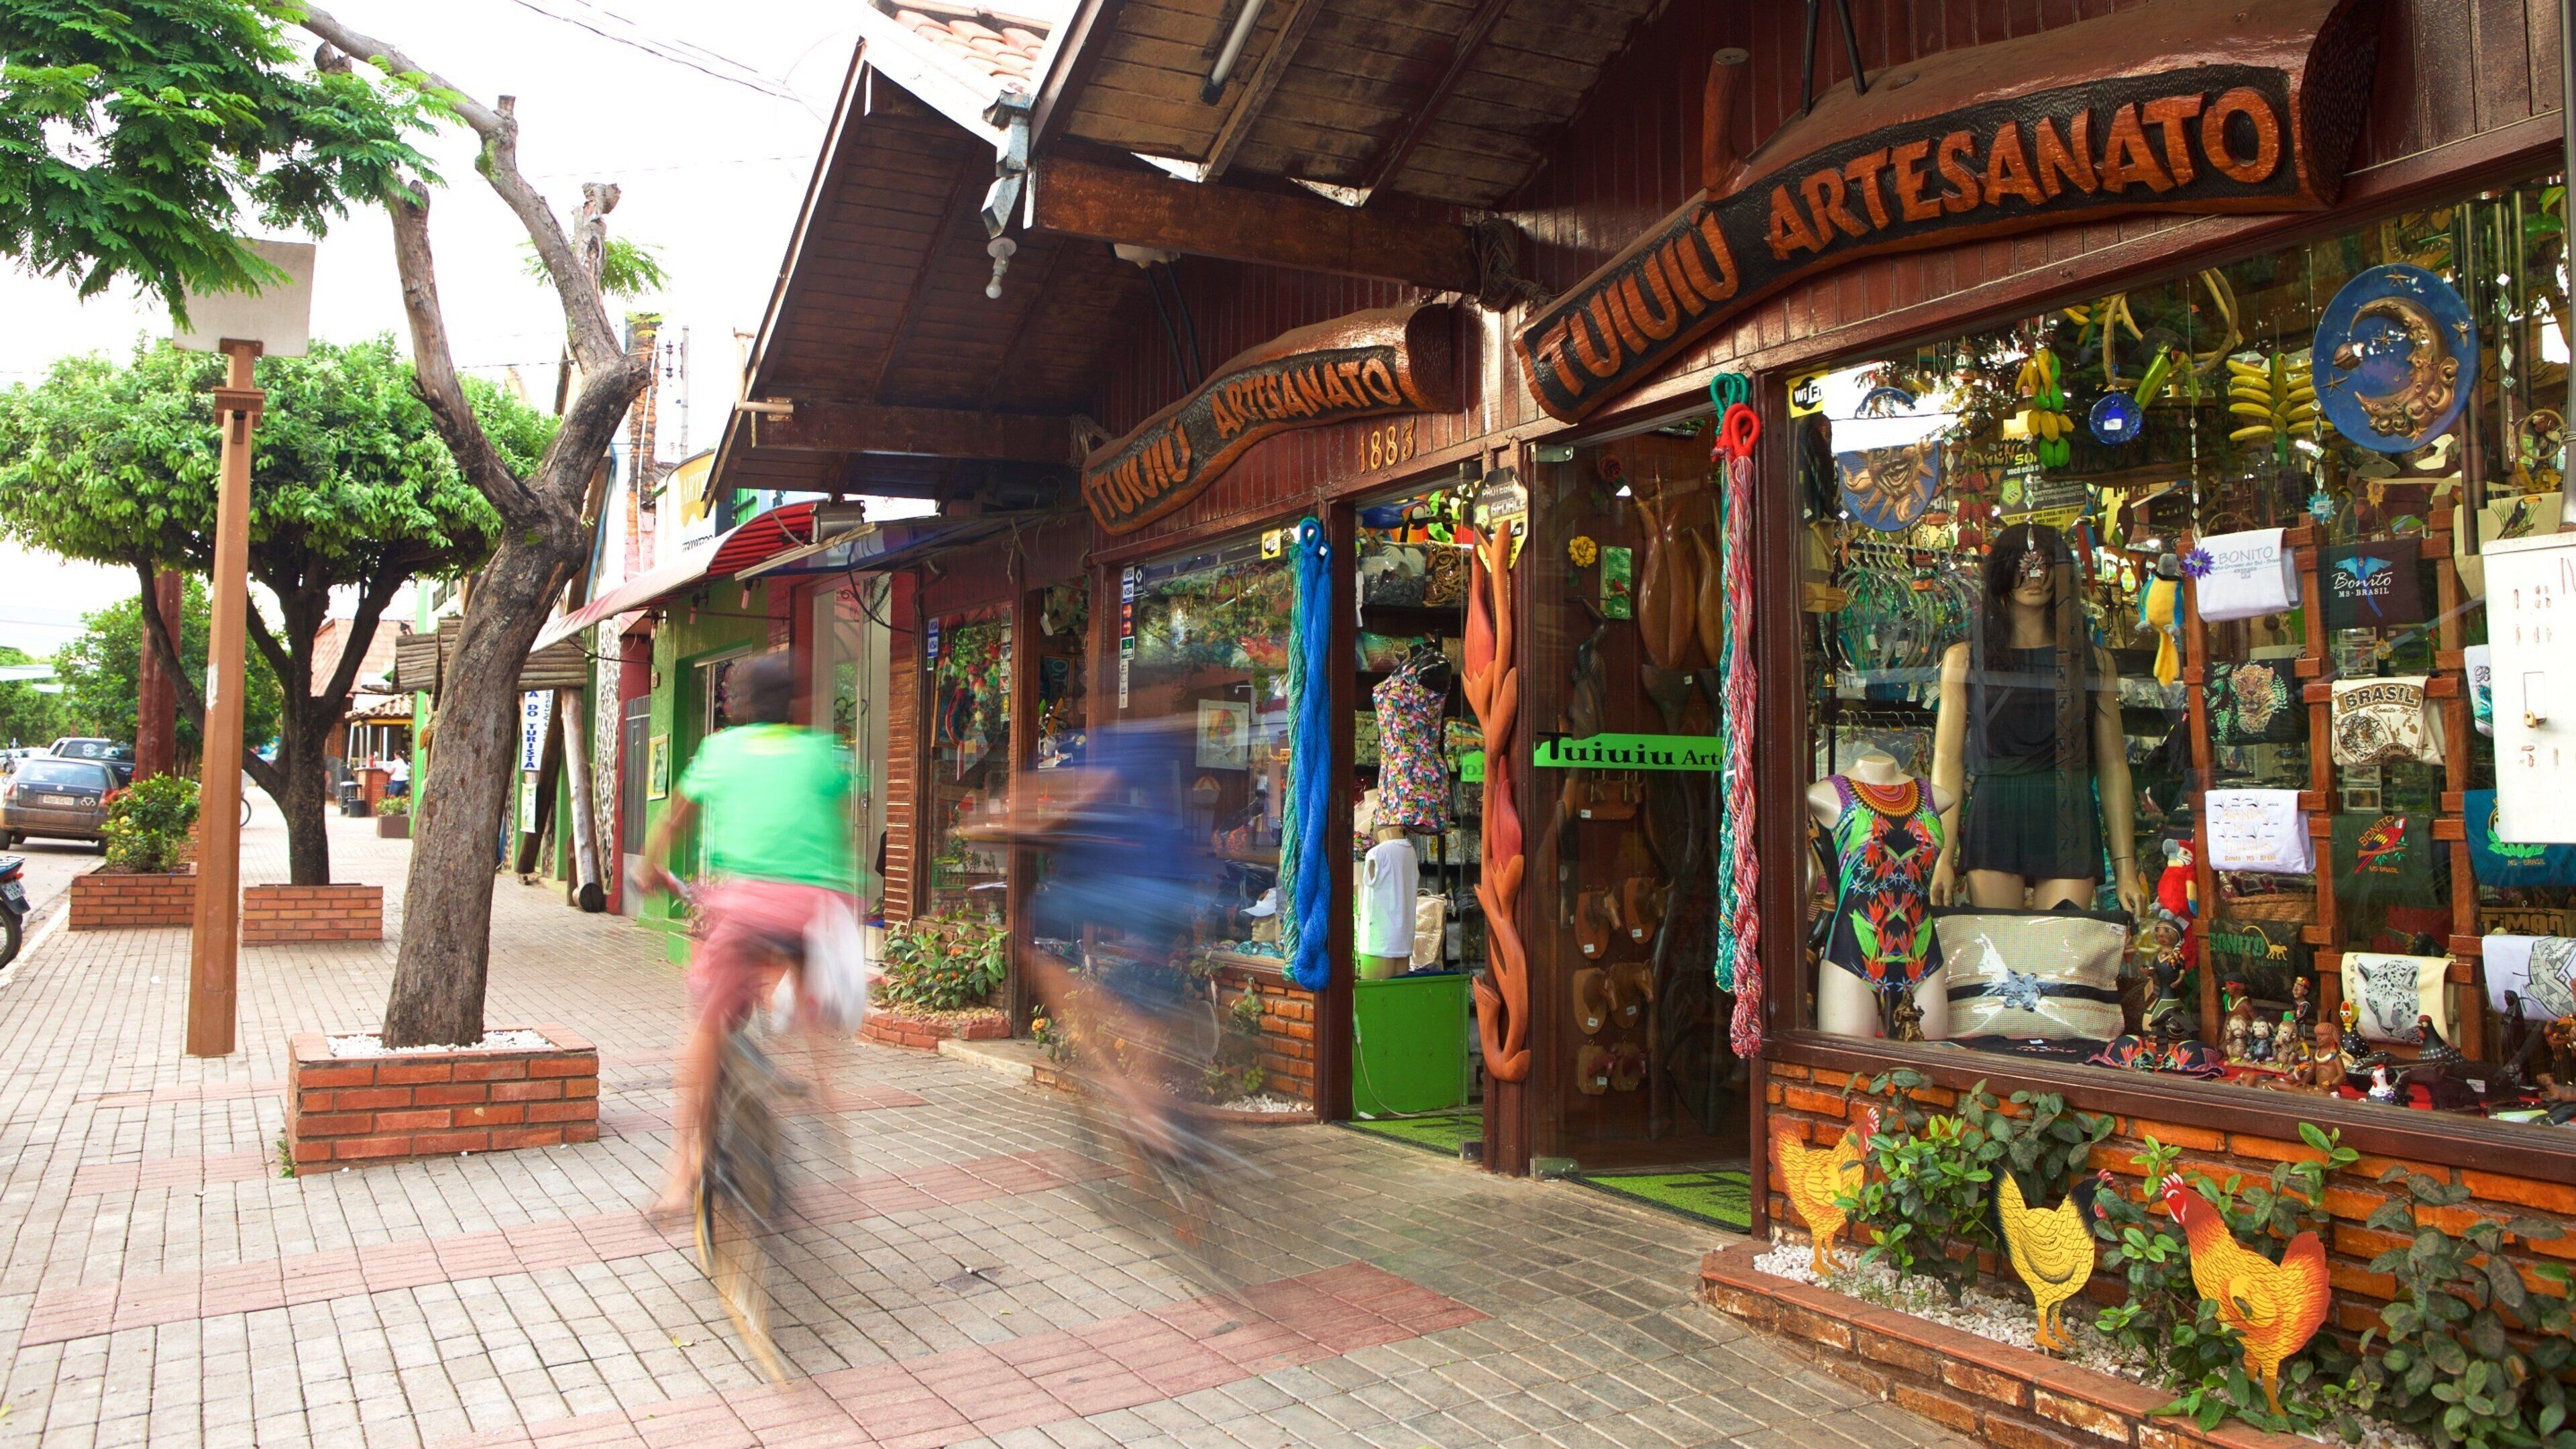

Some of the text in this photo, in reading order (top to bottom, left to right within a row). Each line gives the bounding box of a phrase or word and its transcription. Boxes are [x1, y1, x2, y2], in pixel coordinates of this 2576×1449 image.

[1536, 86, 2280, 397] TUIUIÚ ARTESANATO
[1091, 358, 1401, 519] TUIUIÚ ARTESANATO
[1358, 413, 1416, 474] 1883
[2218, 546, 2273, 565] BONITO
[2331, 572, 2393, 589] Bonito
[2345, 686, 2415, 709] BRASIL
[524, 723, 537, 768] TURISTA
[1537, 731, 1675, 765] Tuiuiu
[2358, 815, 2394, 847] BONITO
